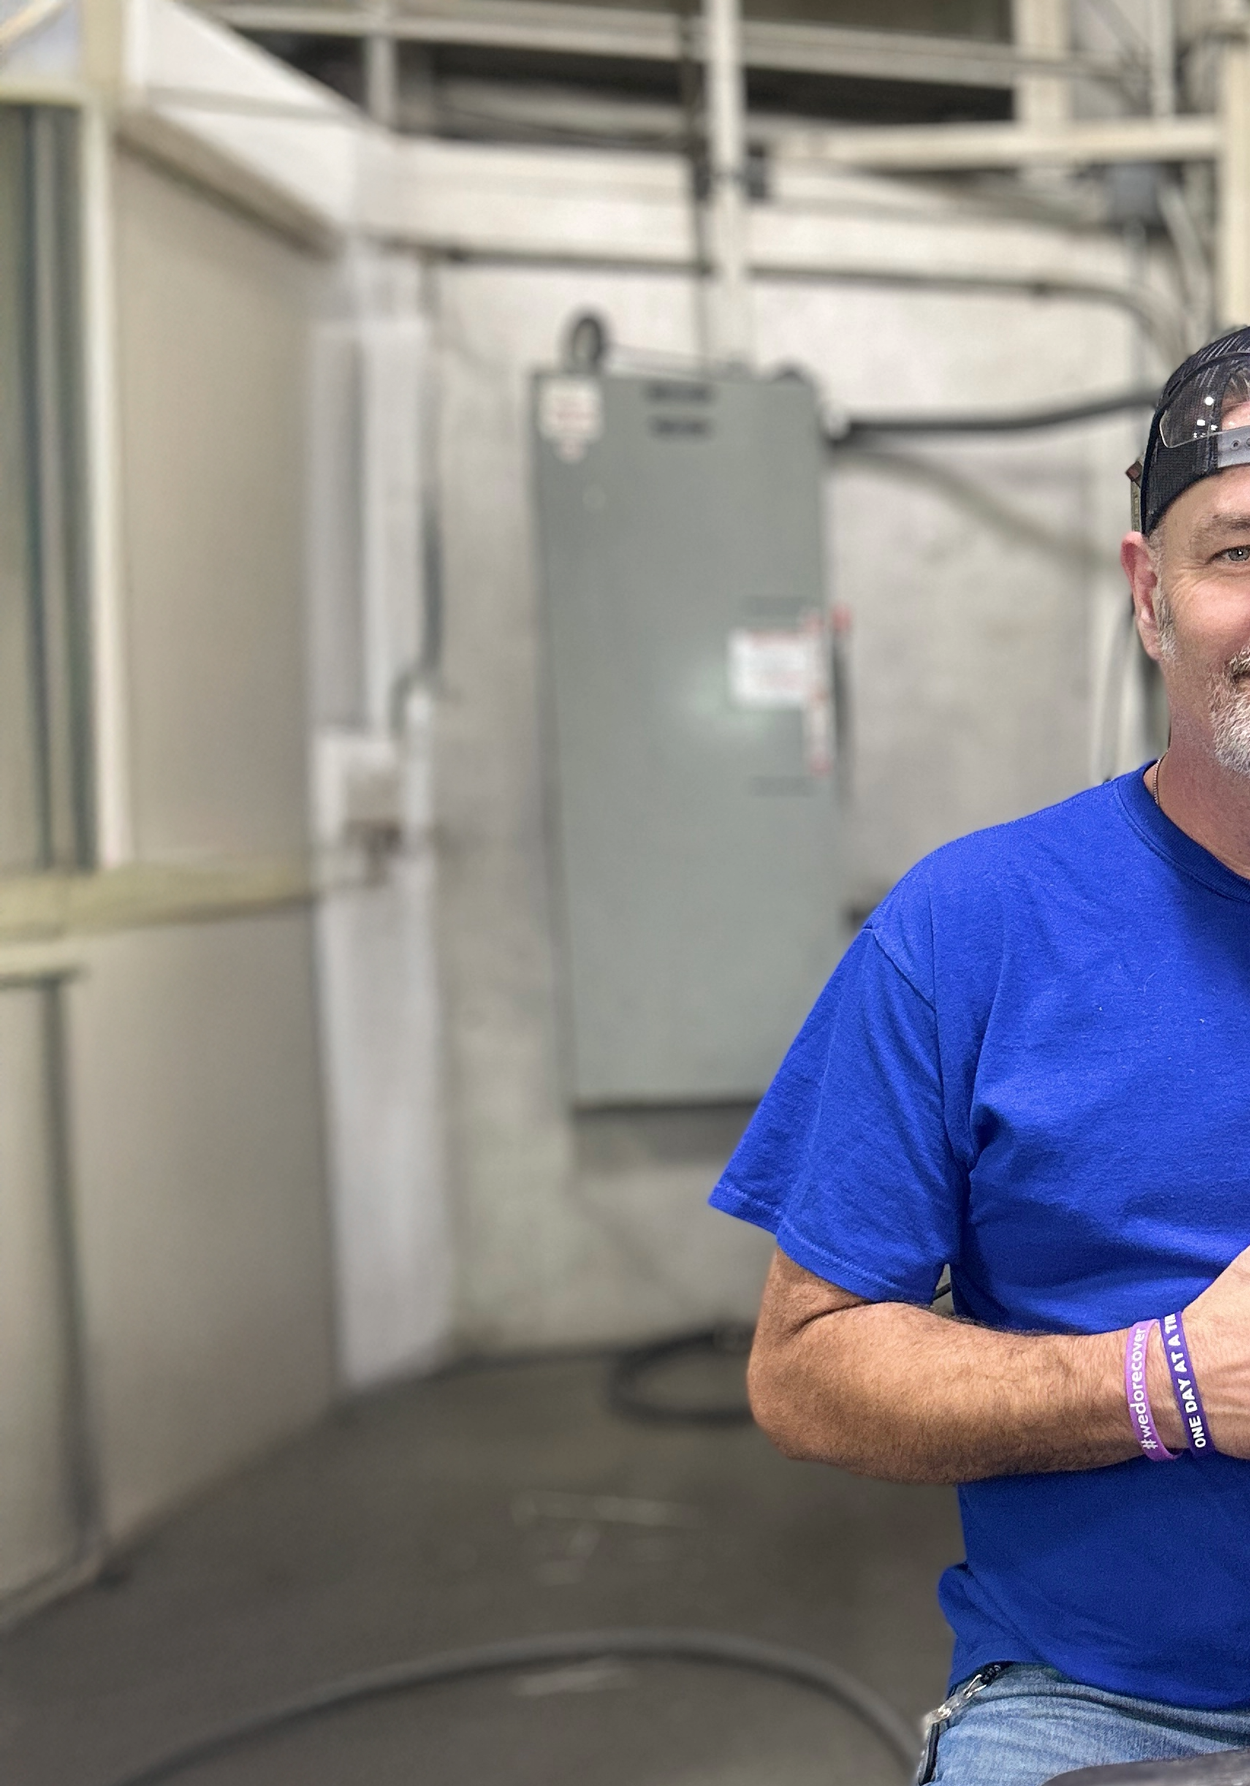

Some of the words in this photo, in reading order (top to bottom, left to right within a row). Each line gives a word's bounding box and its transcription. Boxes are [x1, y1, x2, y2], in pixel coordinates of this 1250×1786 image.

[1168, 1334, 1181, 1347] A
[1171, 1351, 1188, 1373] AT
[1130, 1328, 1158, 1450] #wedorecover
[1178, 1378, 1198, 1413] DAY
[1189, 1415, 1207, 1448] ONE
